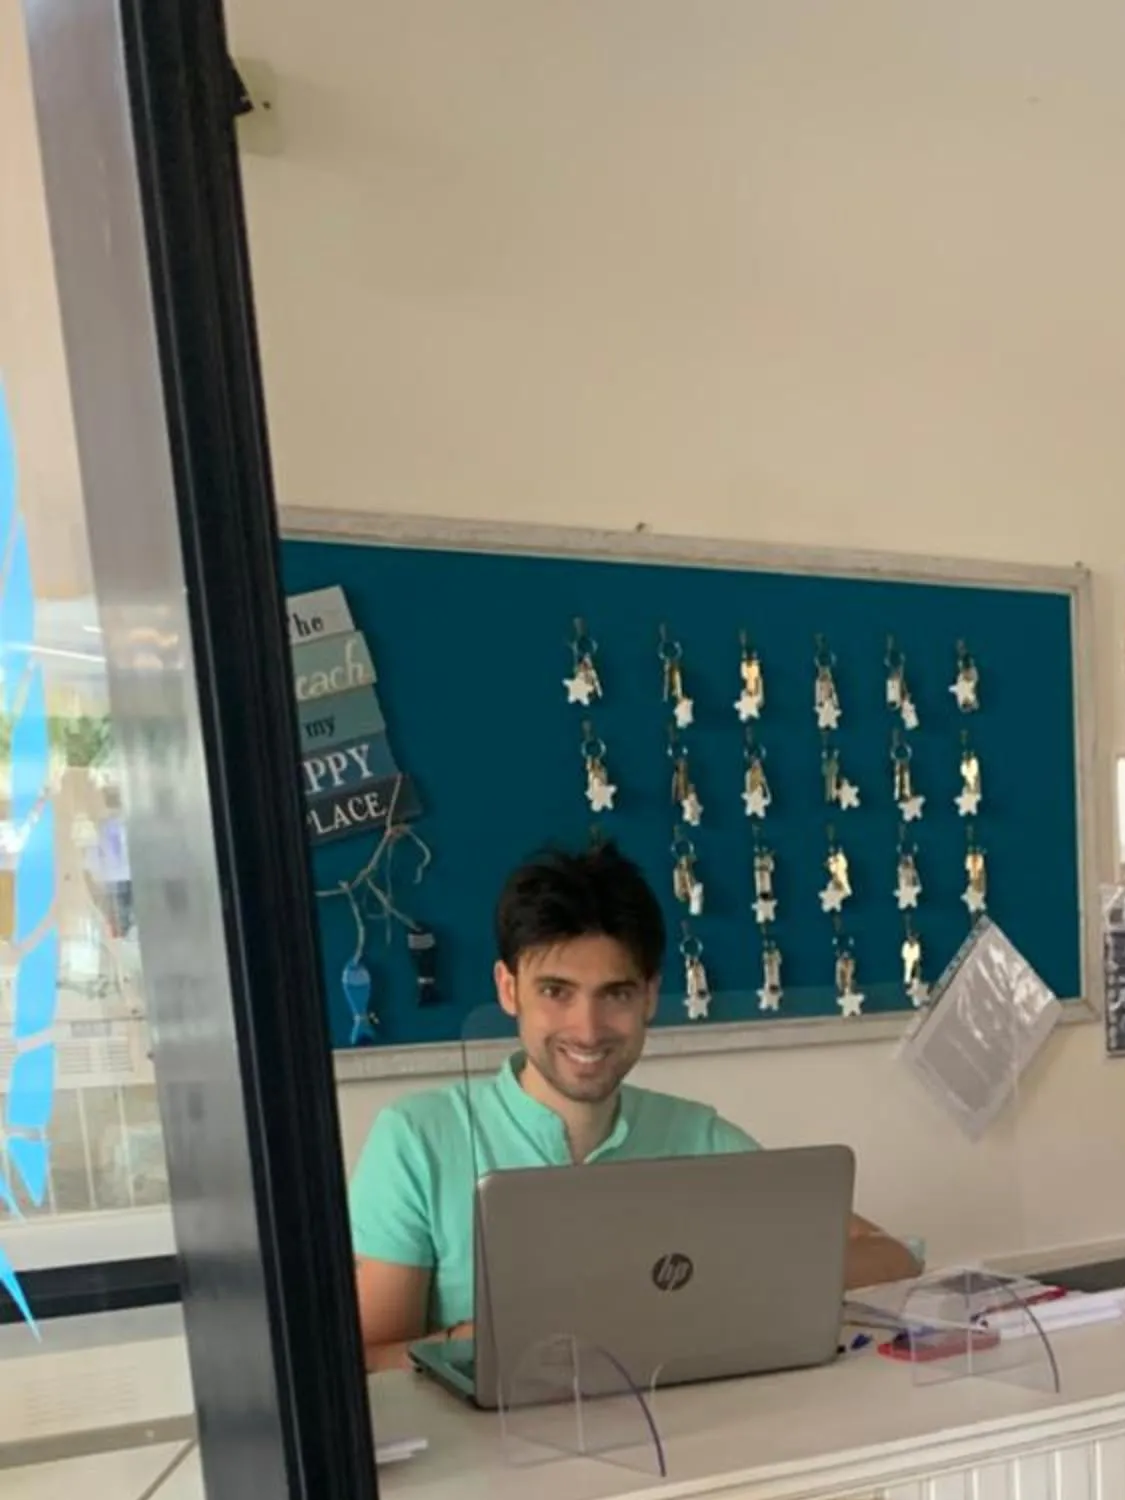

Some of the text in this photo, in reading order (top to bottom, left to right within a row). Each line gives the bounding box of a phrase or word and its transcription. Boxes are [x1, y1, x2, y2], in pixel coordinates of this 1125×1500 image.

[288, 612, 324, 637] he
[304, 714, 336, 739] my
[302, 743, 374, 795] PPY
[652, 1252, 693, 1291] hp
